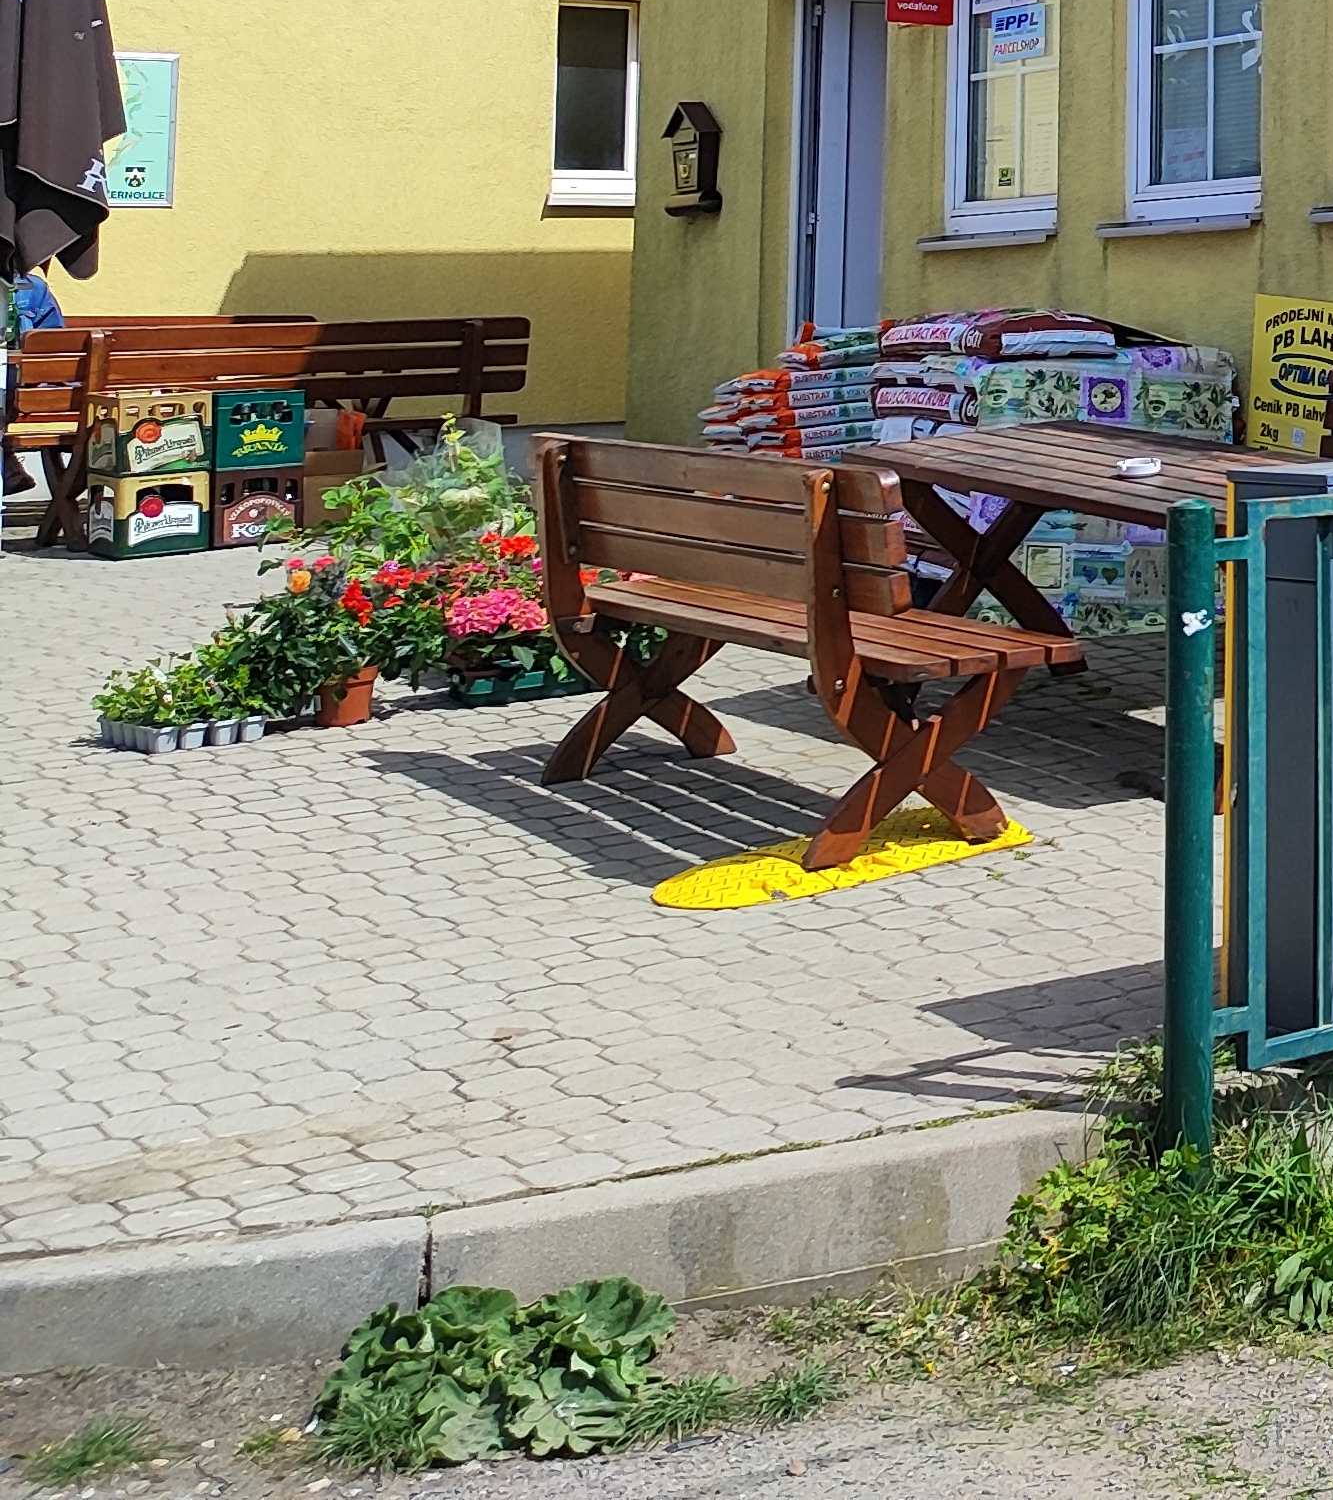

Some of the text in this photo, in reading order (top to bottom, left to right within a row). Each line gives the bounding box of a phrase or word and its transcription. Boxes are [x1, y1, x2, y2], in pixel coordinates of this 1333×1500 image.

[896, 2, 939, 12] vodafone
[1004, 12, 1039, 31] PPL
[993, 38, 1040, 56] PARCELSHOP
[109, 190, 165, 200] ERNOLICE
[1265, 307, 1325, 334] PRODEJNÍ
[1272, 328, 1295, 354] PB
[794, 372, 833, 384] SUBSTRAT
[1278, 362, 1316, 387] OPTIMA
[791, 390, 830, 403] SUBSTRAT
[798, 408, 837, 421] SUBSTRAT
[1253, 395, 1283, 415] Ceník
[1285, 401, 1300, 418] PB
[1259, 422, 1279, 443] 2kg
[134, 433, 197, 464] Pilsner Urquell
[134, 514, 194, 534] Pilsner Urquell
